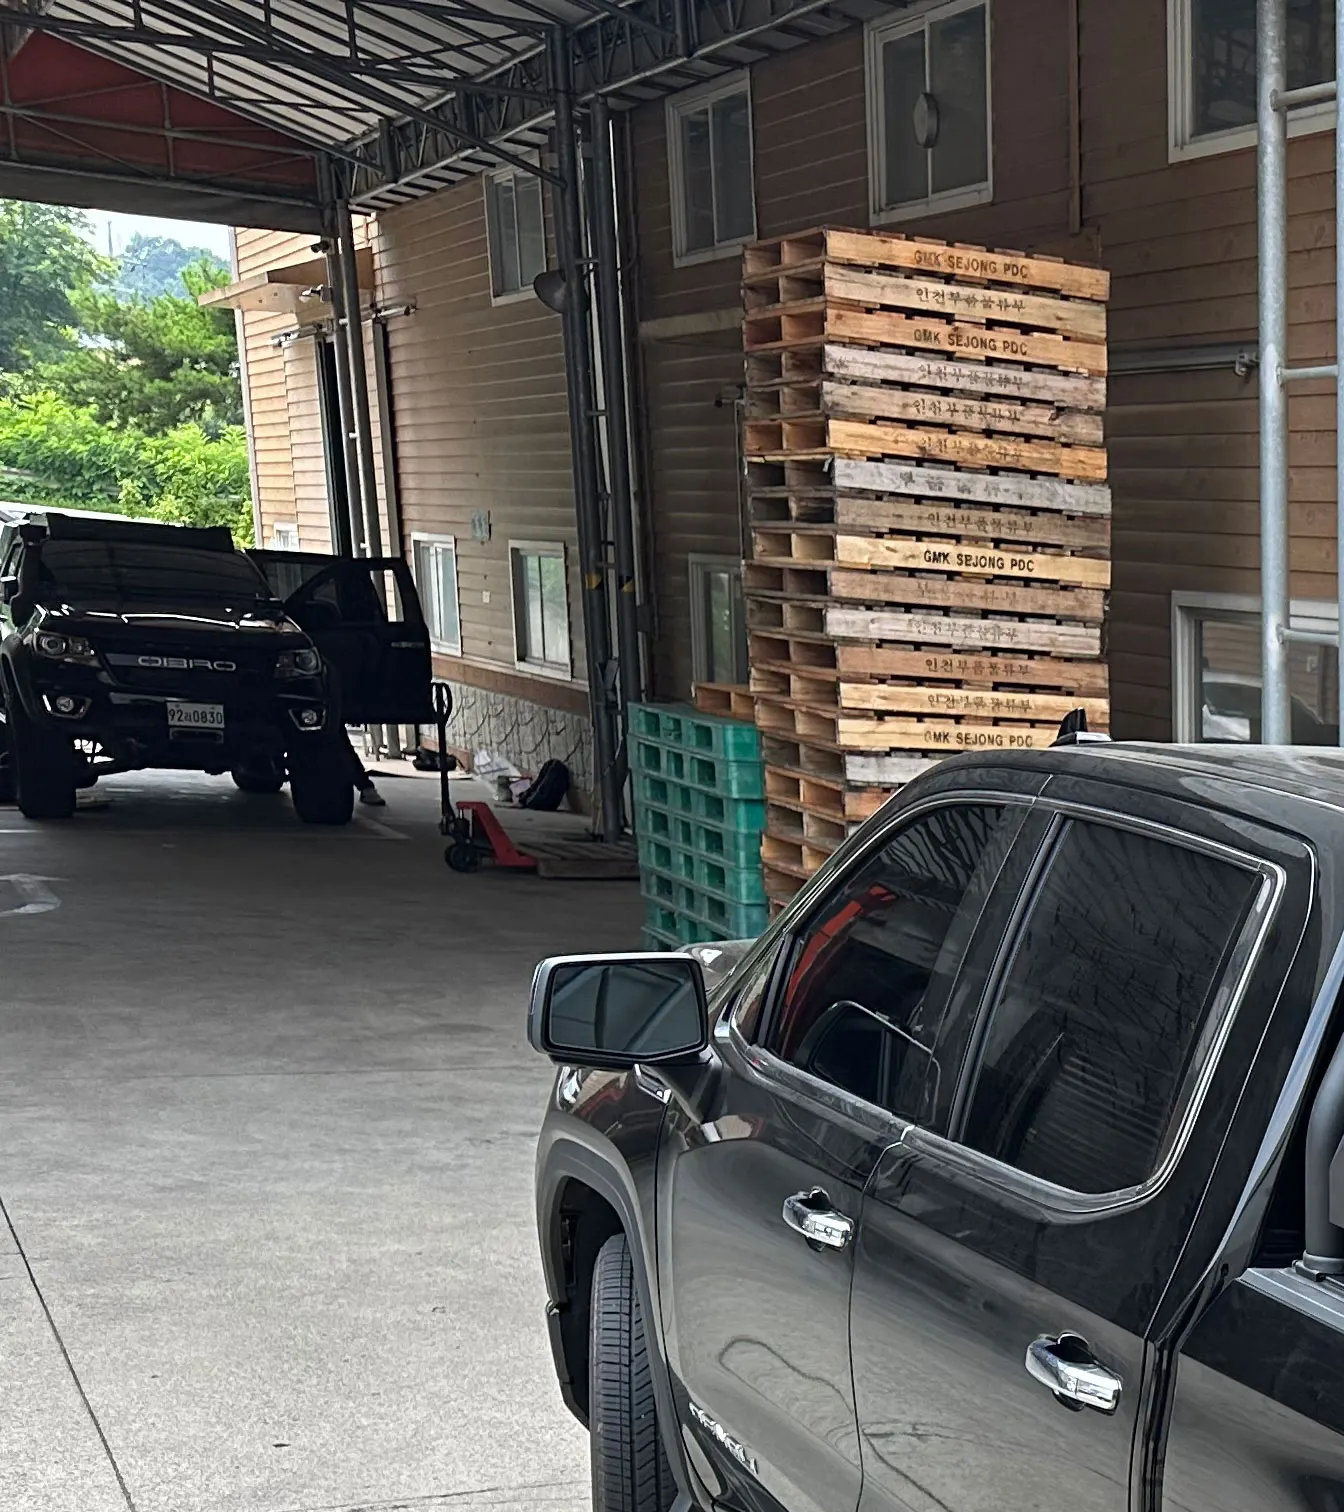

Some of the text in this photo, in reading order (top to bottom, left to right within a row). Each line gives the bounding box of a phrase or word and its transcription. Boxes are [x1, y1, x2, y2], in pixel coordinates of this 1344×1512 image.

[947, 254, 997, 274] SEJONG
[1003, 263, 1028, 278] PDC
[914, 329, 1028, 356] GMK SEJONG PDC
[924, 550, 1035, 572] GMK SEJONG PDC
[956, 732, 1003, 747] SEJONG
[1009, 735, 1033, 748] PDC
